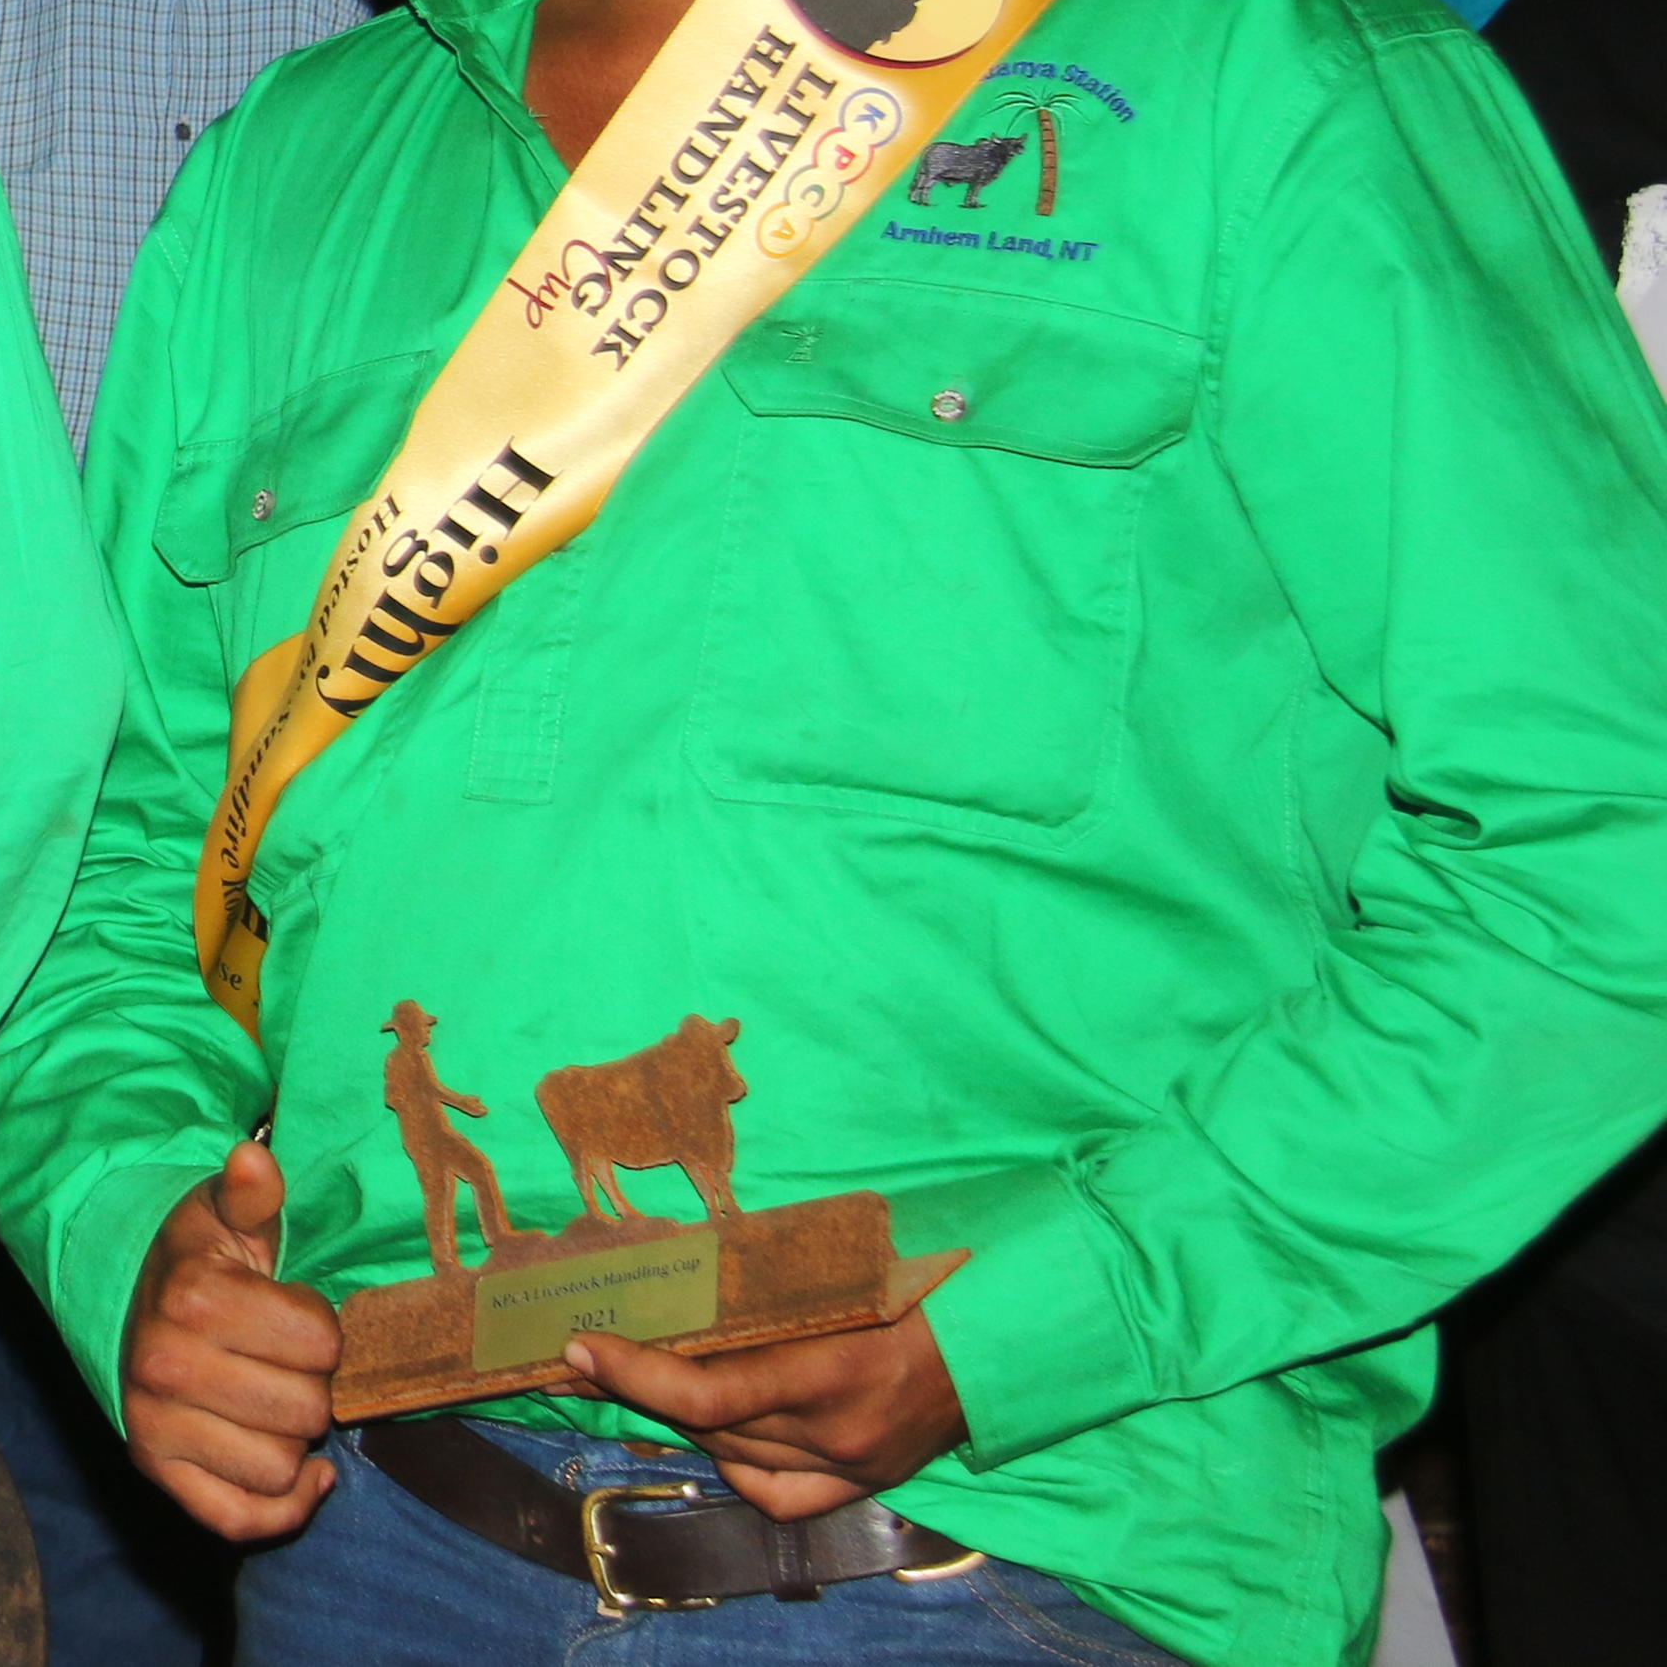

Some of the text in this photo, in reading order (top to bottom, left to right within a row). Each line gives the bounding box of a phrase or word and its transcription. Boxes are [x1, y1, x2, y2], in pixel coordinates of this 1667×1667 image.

[1062, 64, 1136, 124] Station
[571, 24, 797, 318] HANDLING
[764, 95, 894, 249] KPCA
[590, 62, 839, 372] LIVESTOCK
[881, 220, 1100, 262] Arnhem Land, NT
[507, 239, 612, 330] Cup
[491, 1257, 701, 1310] KPCA Livestock Handling Cup
[570, 1307, 617, 1333] 2021
